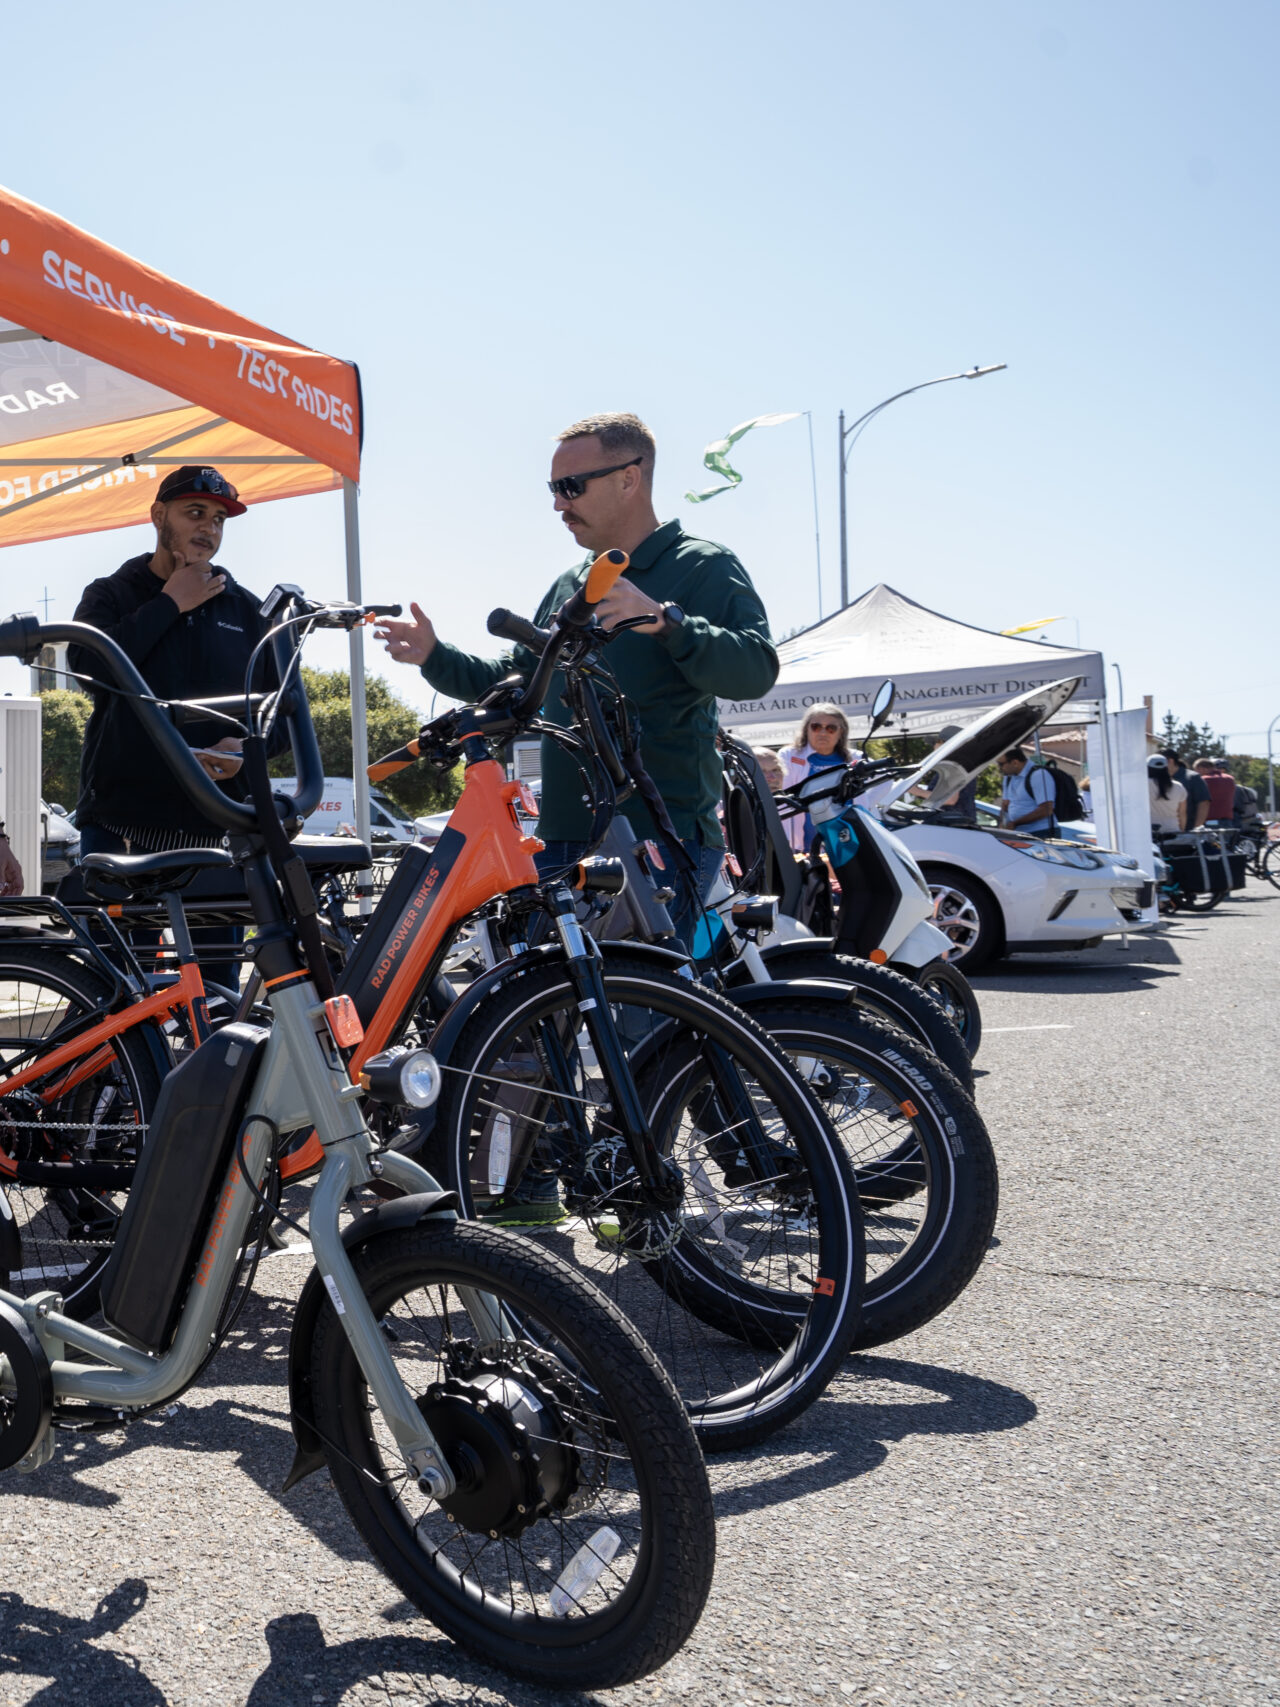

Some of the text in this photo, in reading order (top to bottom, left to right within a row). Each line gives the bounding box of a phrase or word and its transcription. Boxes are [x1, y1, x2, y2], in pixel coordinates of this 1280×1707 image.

[42, 249, 186, 346] SERVICE
[235, 342, 290, 399] TEST
[290, 377, 354, 436] RIDES
[729, 700, 766, 714] AREA
[770, 696, 797, 711] AIR
[801, 692, 870, 710] QUALITY
[891, 682, 999, 701] ANAGEMENT
[371, 867, 440, 988] RAD POWER BIKES
[196, 1135, 252, 1287] RAD POWER BIES
